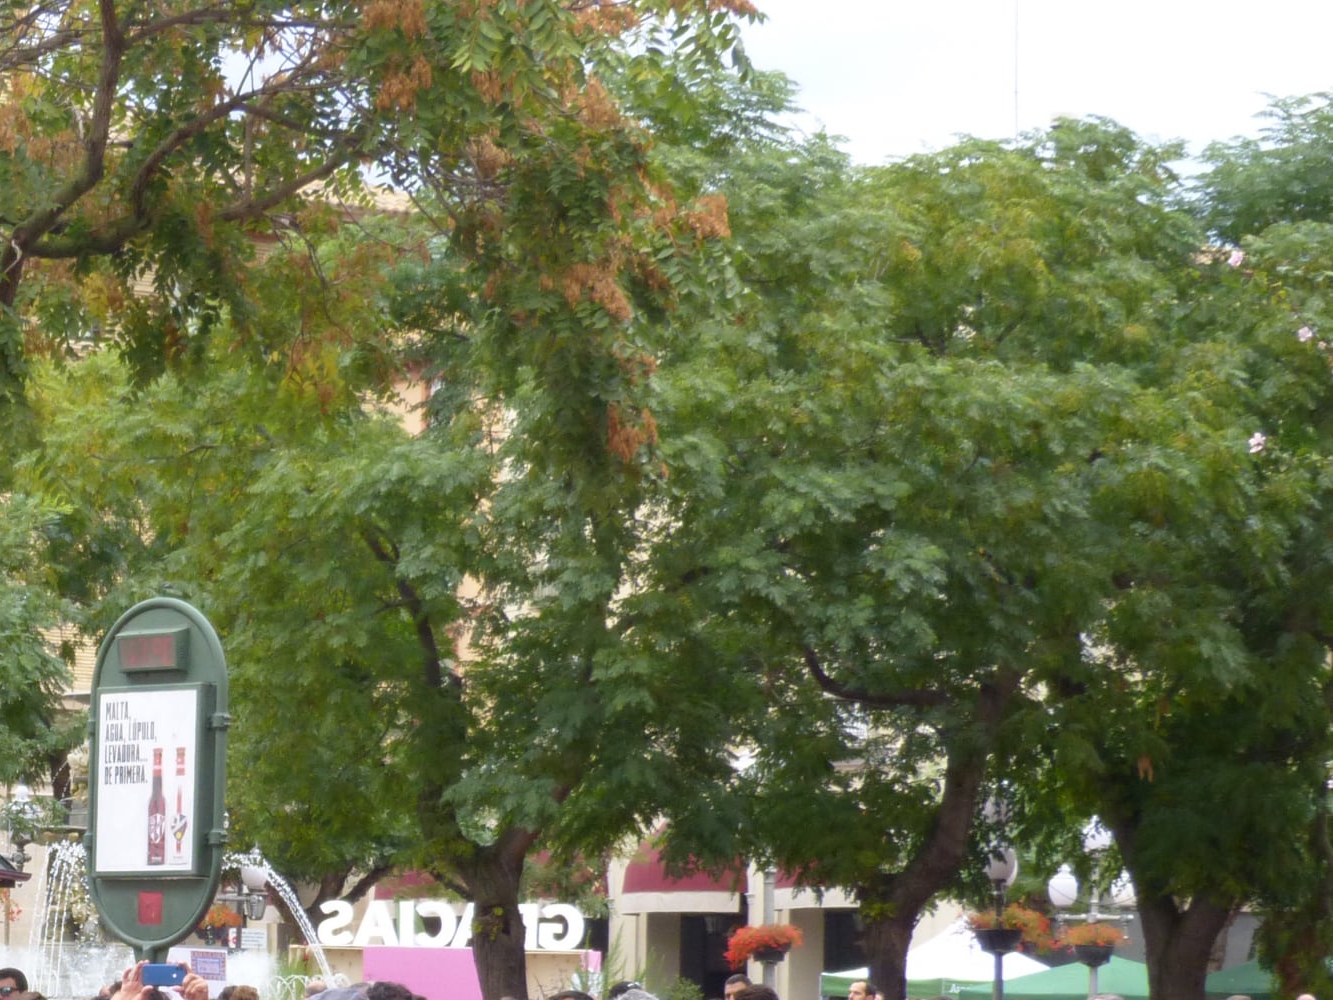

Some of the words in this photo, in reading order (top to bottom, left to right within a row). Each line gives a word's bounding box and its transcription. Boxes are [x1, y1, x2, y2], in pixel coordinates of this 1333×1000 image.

[105, 701, 131, 720] MALTA,
[105, 722, 126, 744] AGUA,
[128, 718, 157, 742] LÚPULO,
[104, 766, 113, 785] DE
[114, 765, 148, 785] PRIMERA.
